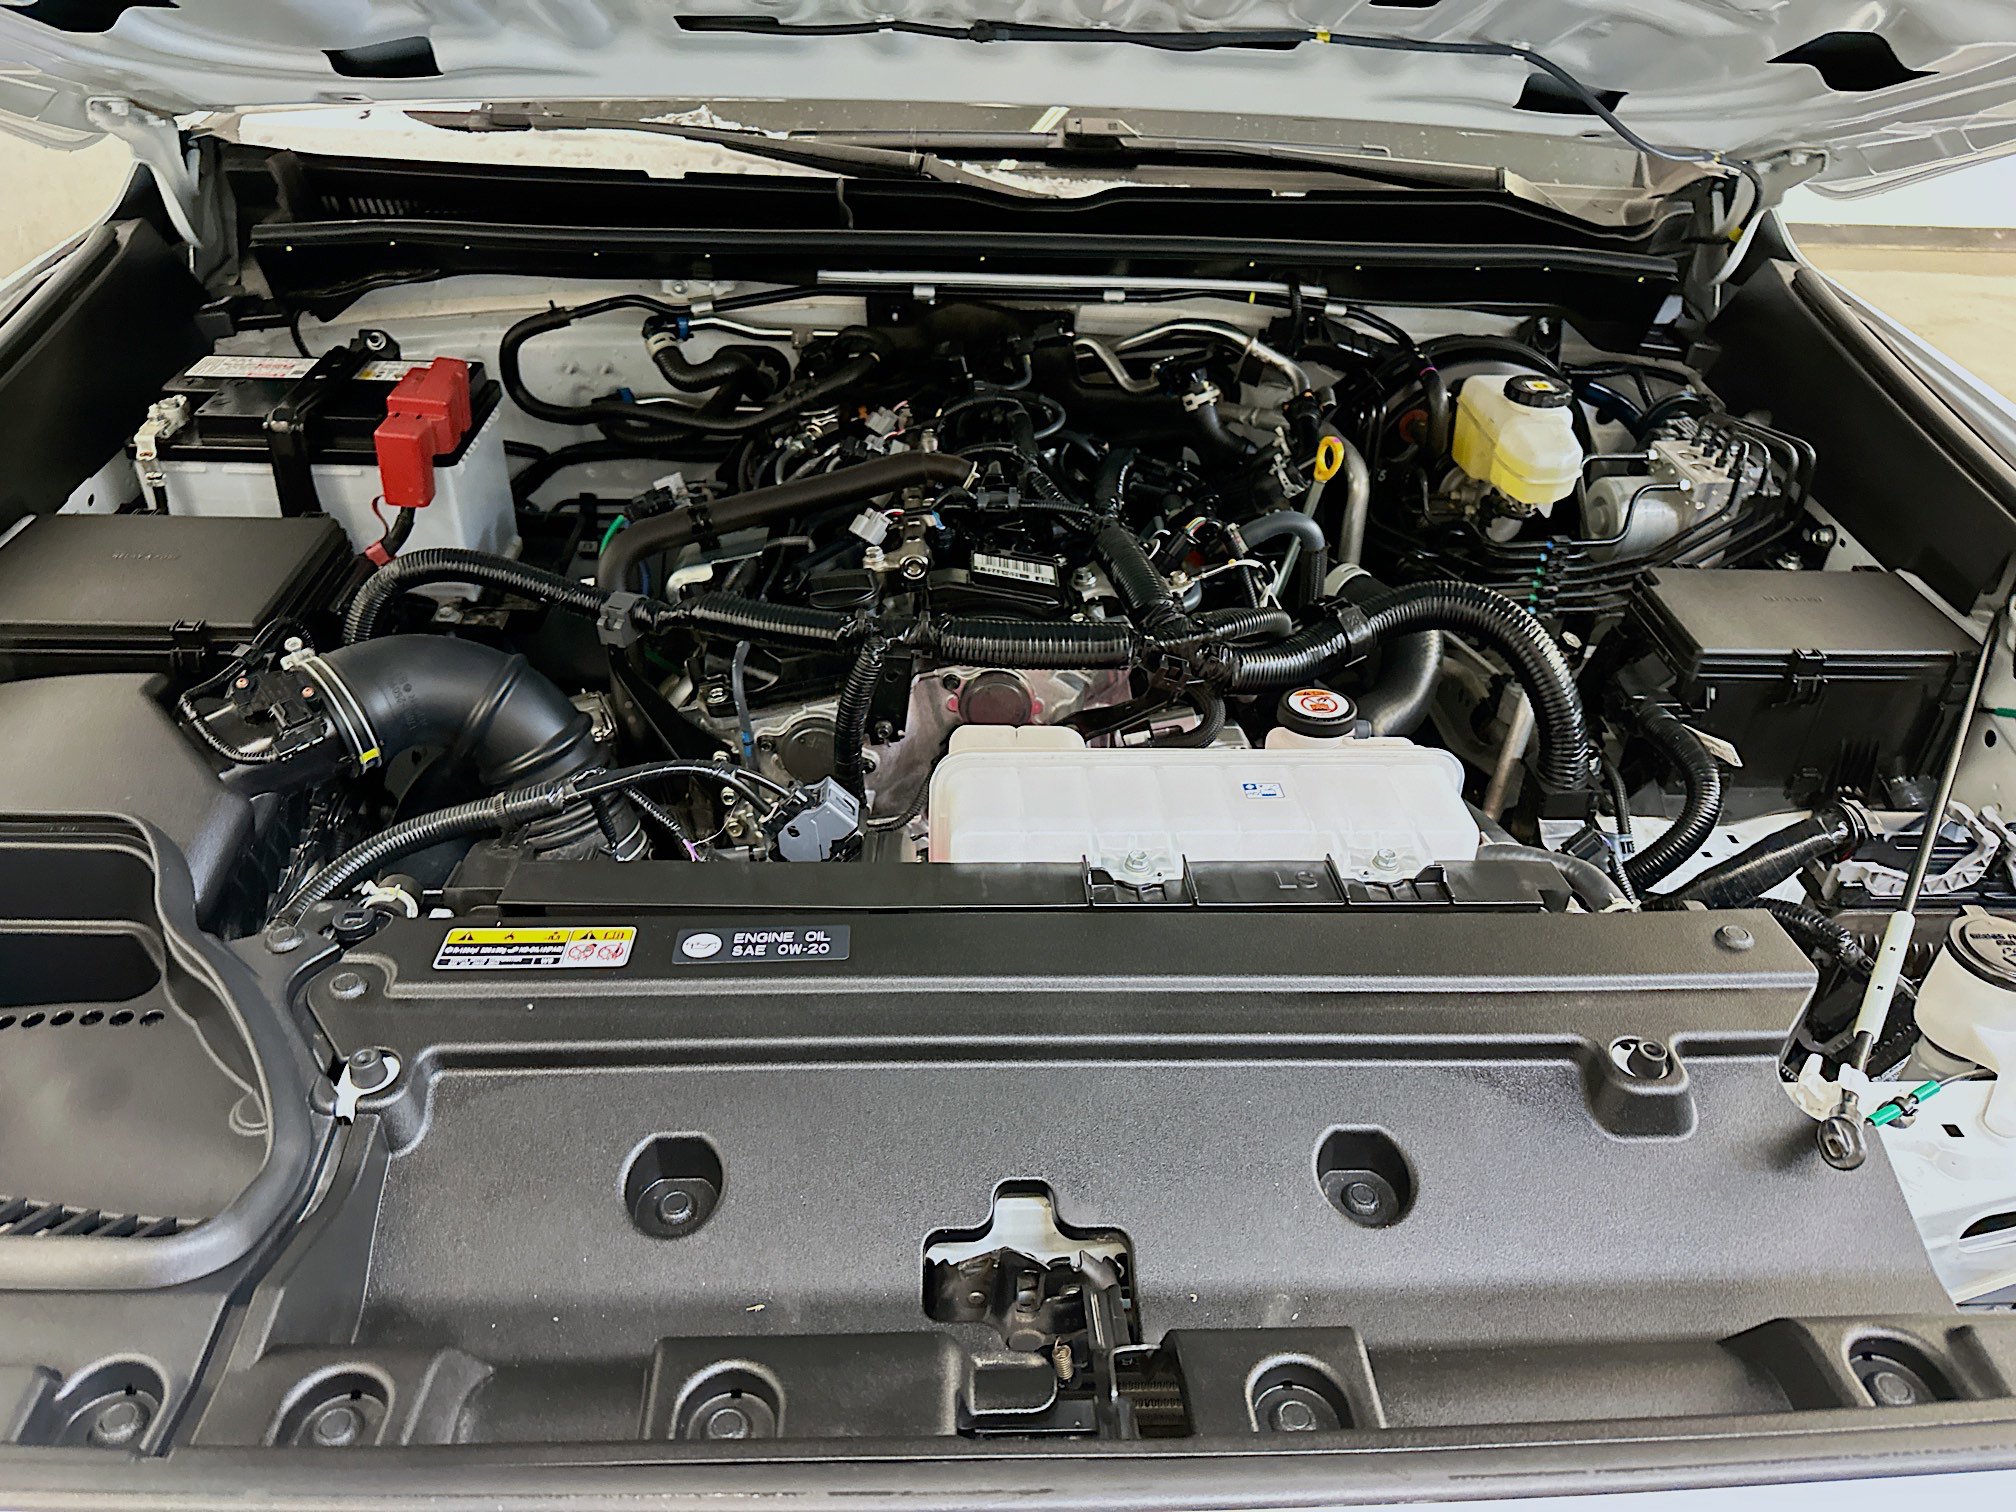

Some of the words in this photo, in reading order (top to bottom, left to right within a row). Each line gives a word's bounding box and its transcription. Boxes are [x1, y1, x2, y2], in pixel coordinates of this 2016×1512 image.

[733, 931, 794, 944] ENGINE
[805, 930, 831, 943] OIL
[731, 945, 766, 957] SAE
[777, 943, 830, 956] 0W-20
